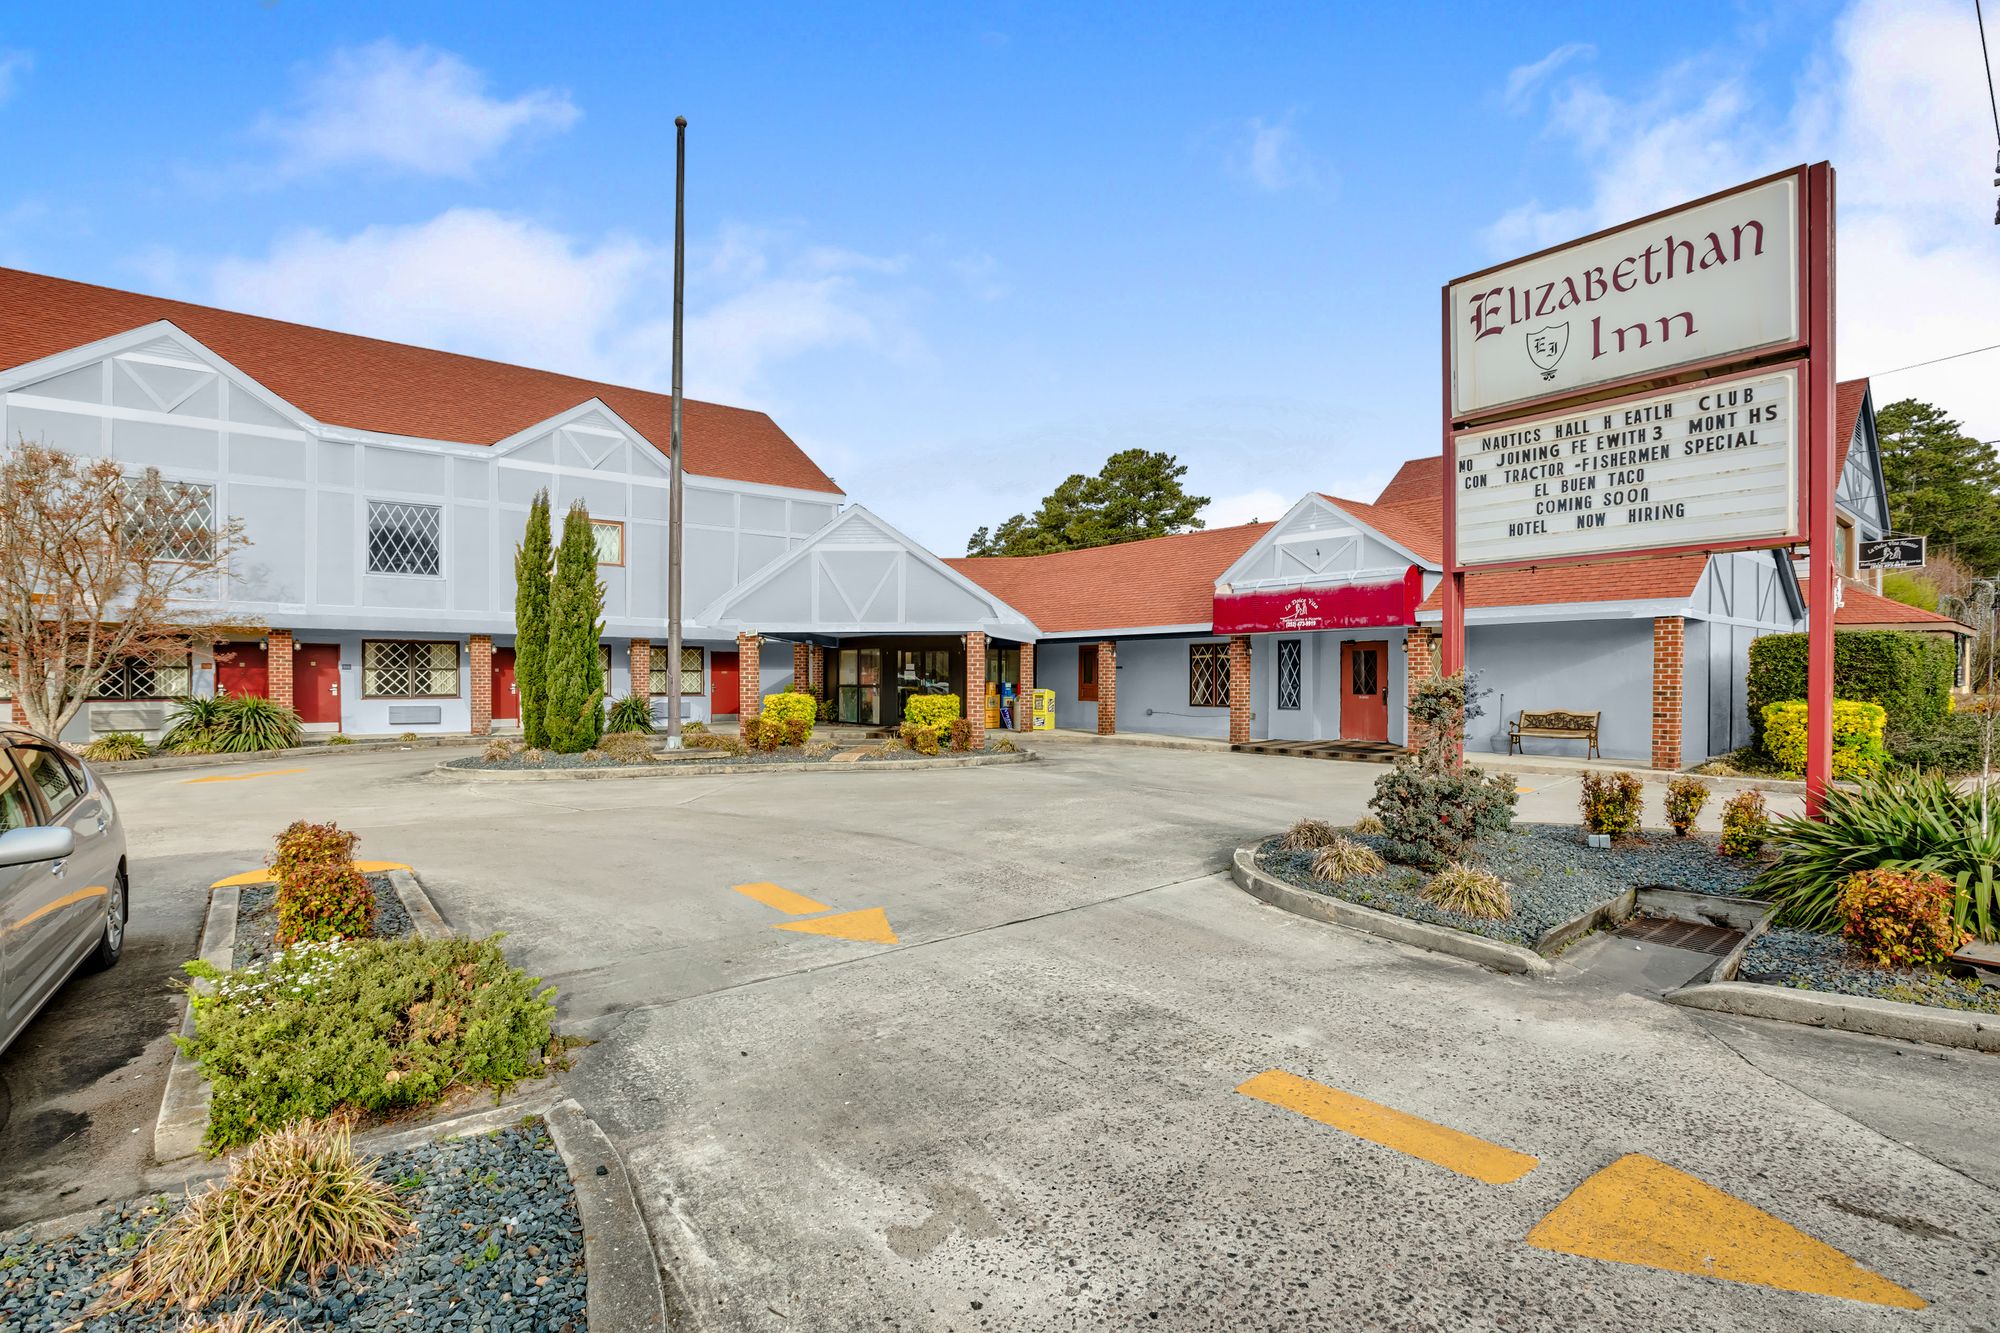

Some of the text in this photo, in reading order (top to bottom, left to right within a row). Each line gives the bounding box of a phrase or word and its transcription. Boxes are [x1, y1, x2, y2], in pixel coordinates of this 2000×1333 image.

[1591, 311, 1698, 360] Inn
[1482, 428, 1541, 451] NAUTICS
[1555, 420, 1590, 439] HALL
[1698, 388, 1753, 411] CLUB
[1458, 459, 1473, 473] NO
[1496, 444, 1560, 467] JOINING
[1652, 425, 1663, 441] 3
[1684, 430, 1758, 456] SPECIAL
[1534, 468, 1645, 497] EL BUEN TACO
[1536, 487, 1649, 515] COMING SOON
[1509, 503, 1685, 537] HOTEL NOW HIRING
